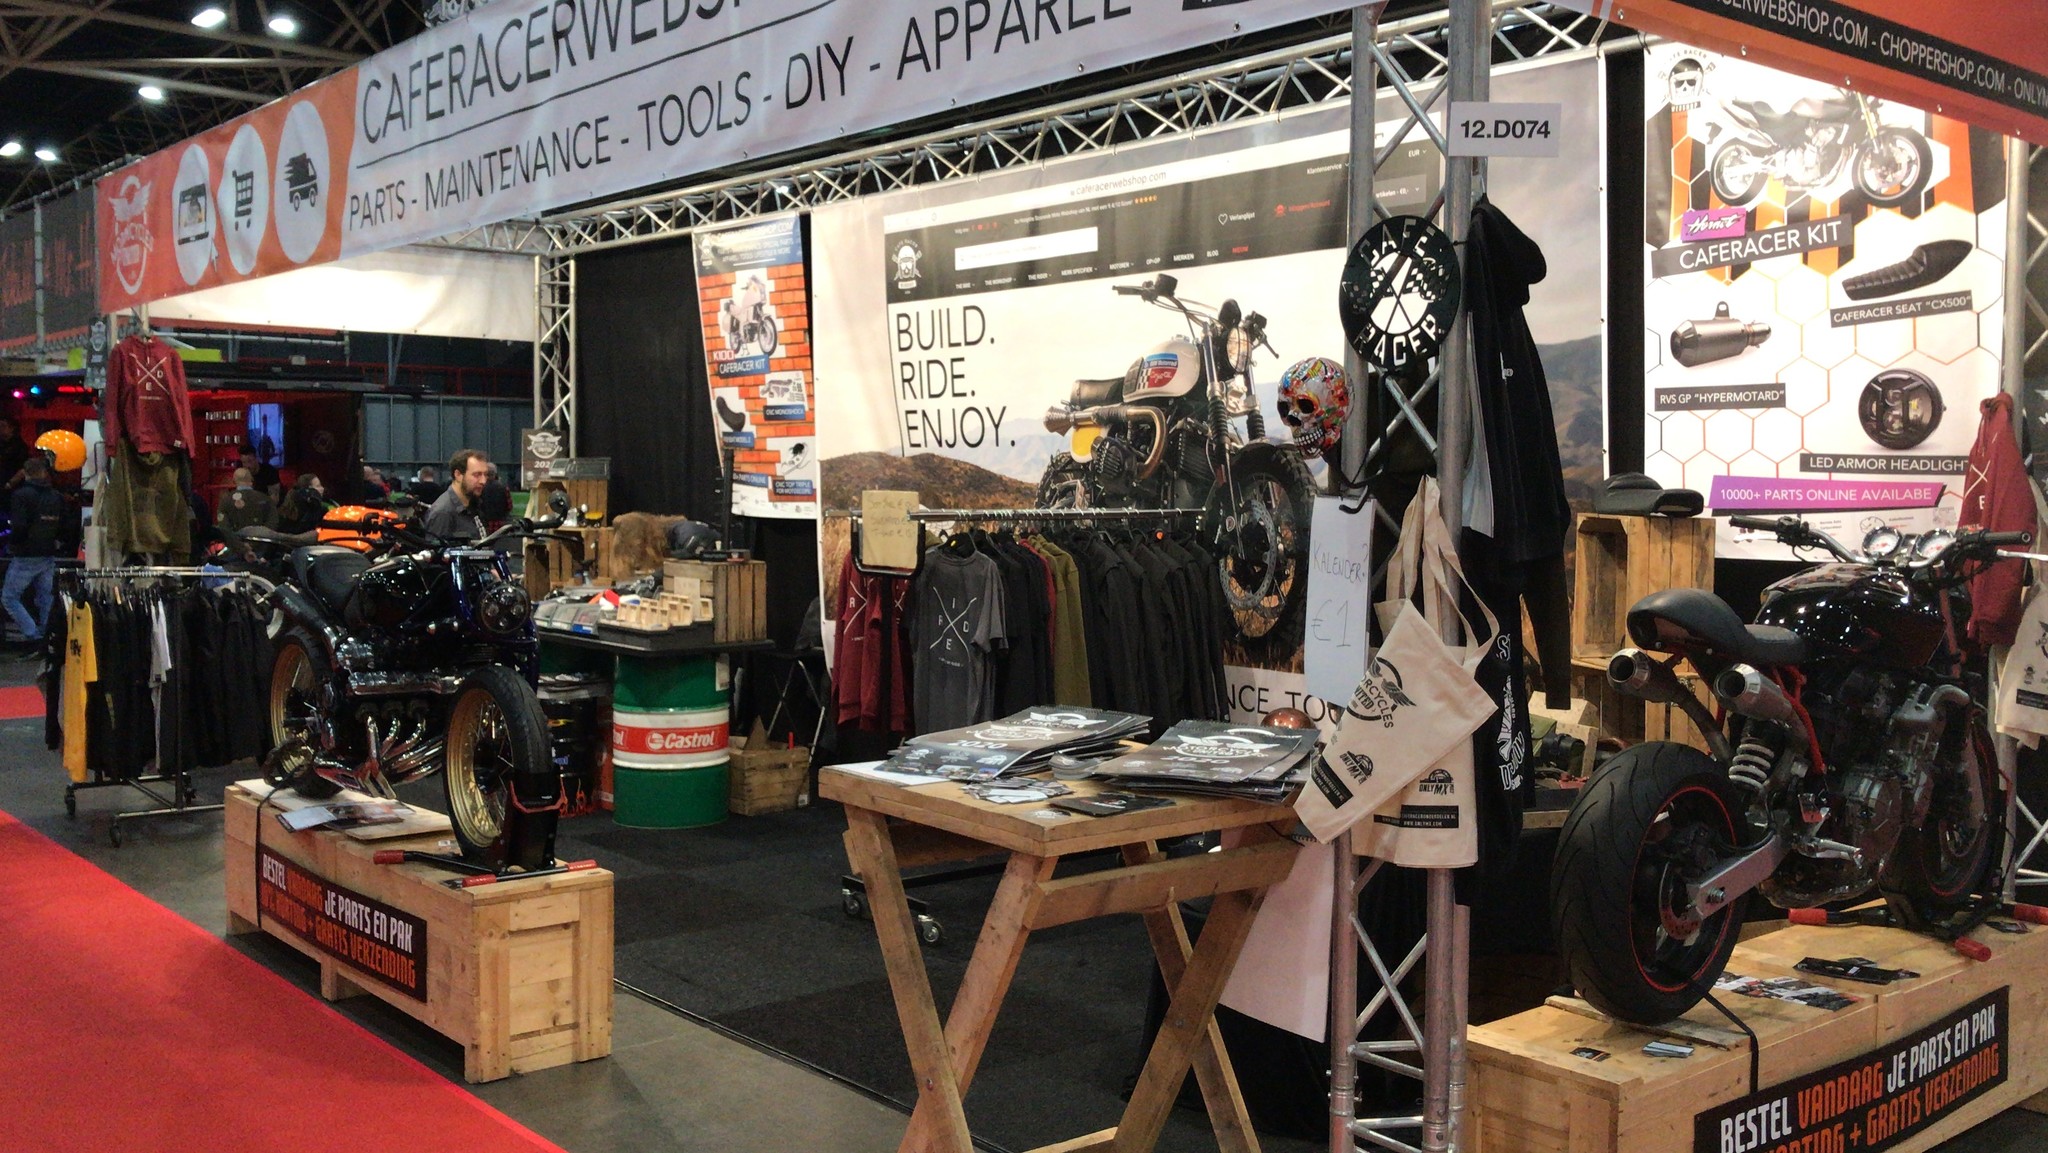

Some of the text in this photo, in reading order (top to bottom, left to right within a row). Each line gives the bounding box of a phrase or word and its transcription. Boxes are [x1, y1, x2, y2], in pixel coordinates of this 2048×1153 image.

[1880, 31, 2004, 93] CHOPPERSHOP.COM
[349, 180, 405, 231] PARTS
[425, 116, 611, 212] MAINTENANCE
[638, 71, 752, 151] TOOLS
[785, 36, 854, 110] DIY
[1461, 120, 1550, 139] 12.D074
[1409, 149, 1420, 158] EUR
[1306, 163, 1342, 175] Klantenservice
[1076, 171, 1167, 196] caferacerwebshop.com
[1229, 212, 1256, 222] Verlanglijst
[1173, 253, 1194, 261] MERKEN
[1206, 249, 1219, 257] BLOG
[1679, 221, 1842, 270] CAFERACER KIT
[1834, 306, 1893, 323] CAFERACER
[1895, 302, 1922, 315] SEAT
[896, 305, 995, 352] BUILD.
[719, 358, 766, 375] CAFERACER KIT
[900, 357, 975, 400] RIDE.
[1660, 394, 1676, 405] RVS
[1678, 393, 1692, 403] GP
[905, 405, 1016, 448] ENJOY.
[1810, 457, 1833, 469] LED
[1836, 457, 1887, 470] ARMOR
[1720, 487, 1932, 501] 10000+ PARTS ONLINE AVAILABE
[1310, 598, 1351, 648] €1
[664, 731, 714, 749] Castrol
[947, 740, 1008, 750] 2020
[1160, 756, 1231, 764] 2020
[262, 853, 287, 891] BESTEL
[324, 889, 337, 919] JE
[338, 894, 371, 935] PARTS
[390, 915, 413, 953] PAK
[315, 914, 348, 955] GRATIS
[350, 932, 416, 989] VERZENDING
[1720, 1096, 1792, 1153] BESTEL
[1798, 1061, 1884, 1129] VANDAAG
[1887, 1049, 1906, 1093] JE
[1909, 1031, 1951, 1083] PARTS
[1971, 1003, 1996, 1048] PAK
[1866, 1087, 1921, 1147] GRATIS
[1924, 1043, 1999, 1118] VERZENDING
